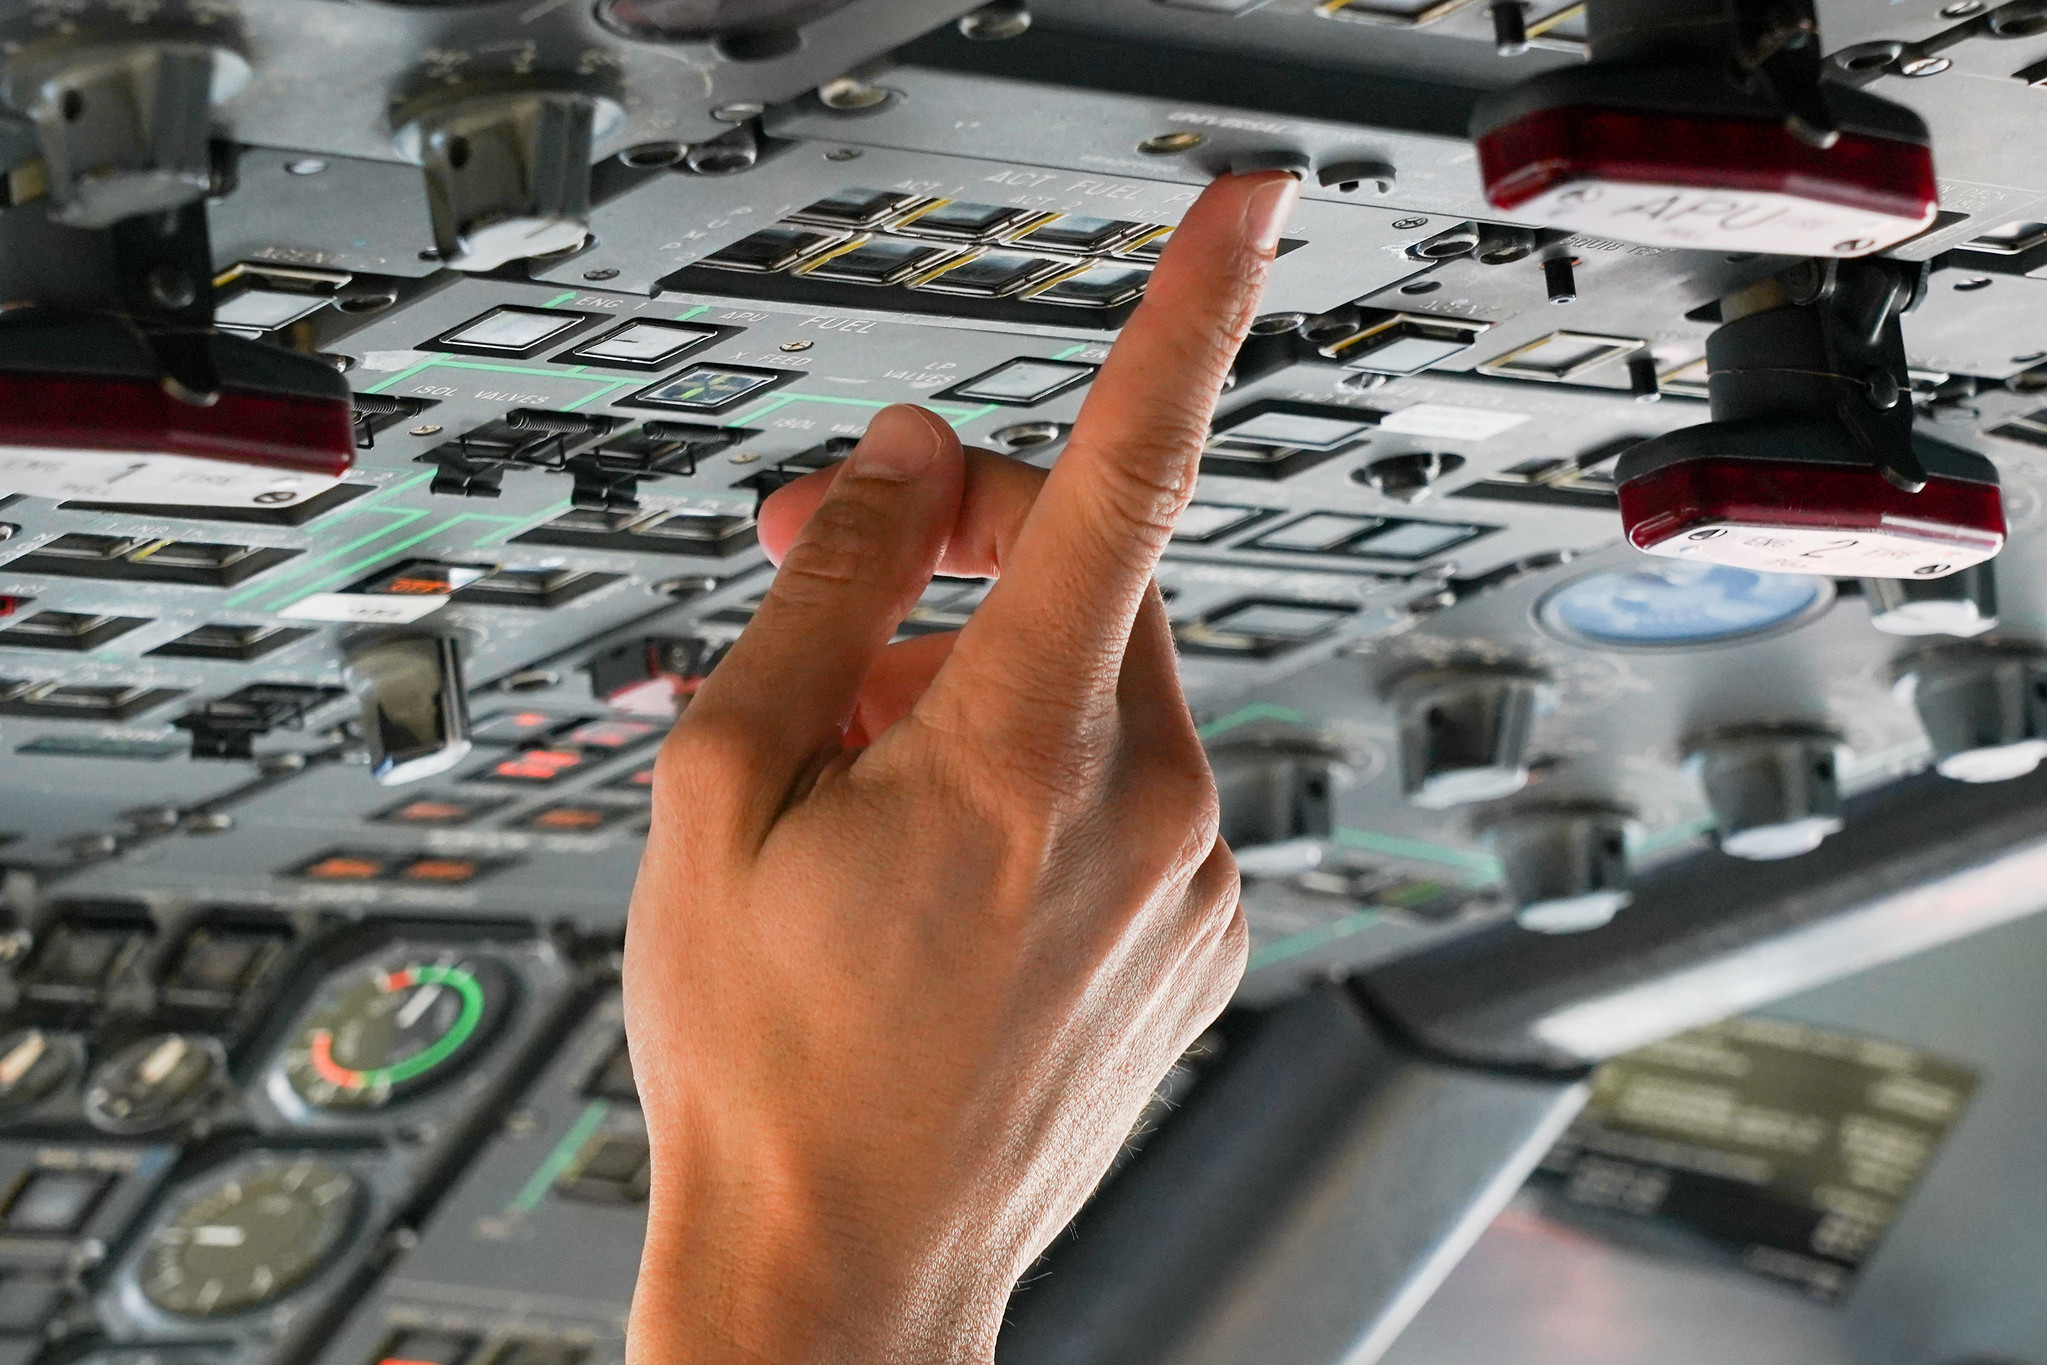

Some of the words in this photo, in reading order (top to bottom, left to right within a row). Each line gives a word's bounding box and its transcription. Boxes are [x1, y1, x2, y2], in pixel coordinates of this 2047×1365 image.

[984, 169, 1057, 189] ACT
[1065, 179, 1146, 201] FUEL
[1008, 194, 1057, 211] ACT
[1124, 208, 1172, 221] ACT
[1609, 195, 1792, 232] APU
[575, 295, 625, 310] ENG
[717, 310, 772, 323] APU
[797, 314, 879, 336] FUEL
[727, 350, 745, 361] X
[759, 353, 813, 368] FEED
[1080, 348, 1110, 359] EN
[923, 360, 958, 372] LP
[883, 368, 958, 385] VALVES
[410, 384, 458, 398] ISOL
[473, 389, 551, 406] VALVES
[772, 417, 817, 432] ISOL
[1799, 538, 1860, 560] 2
